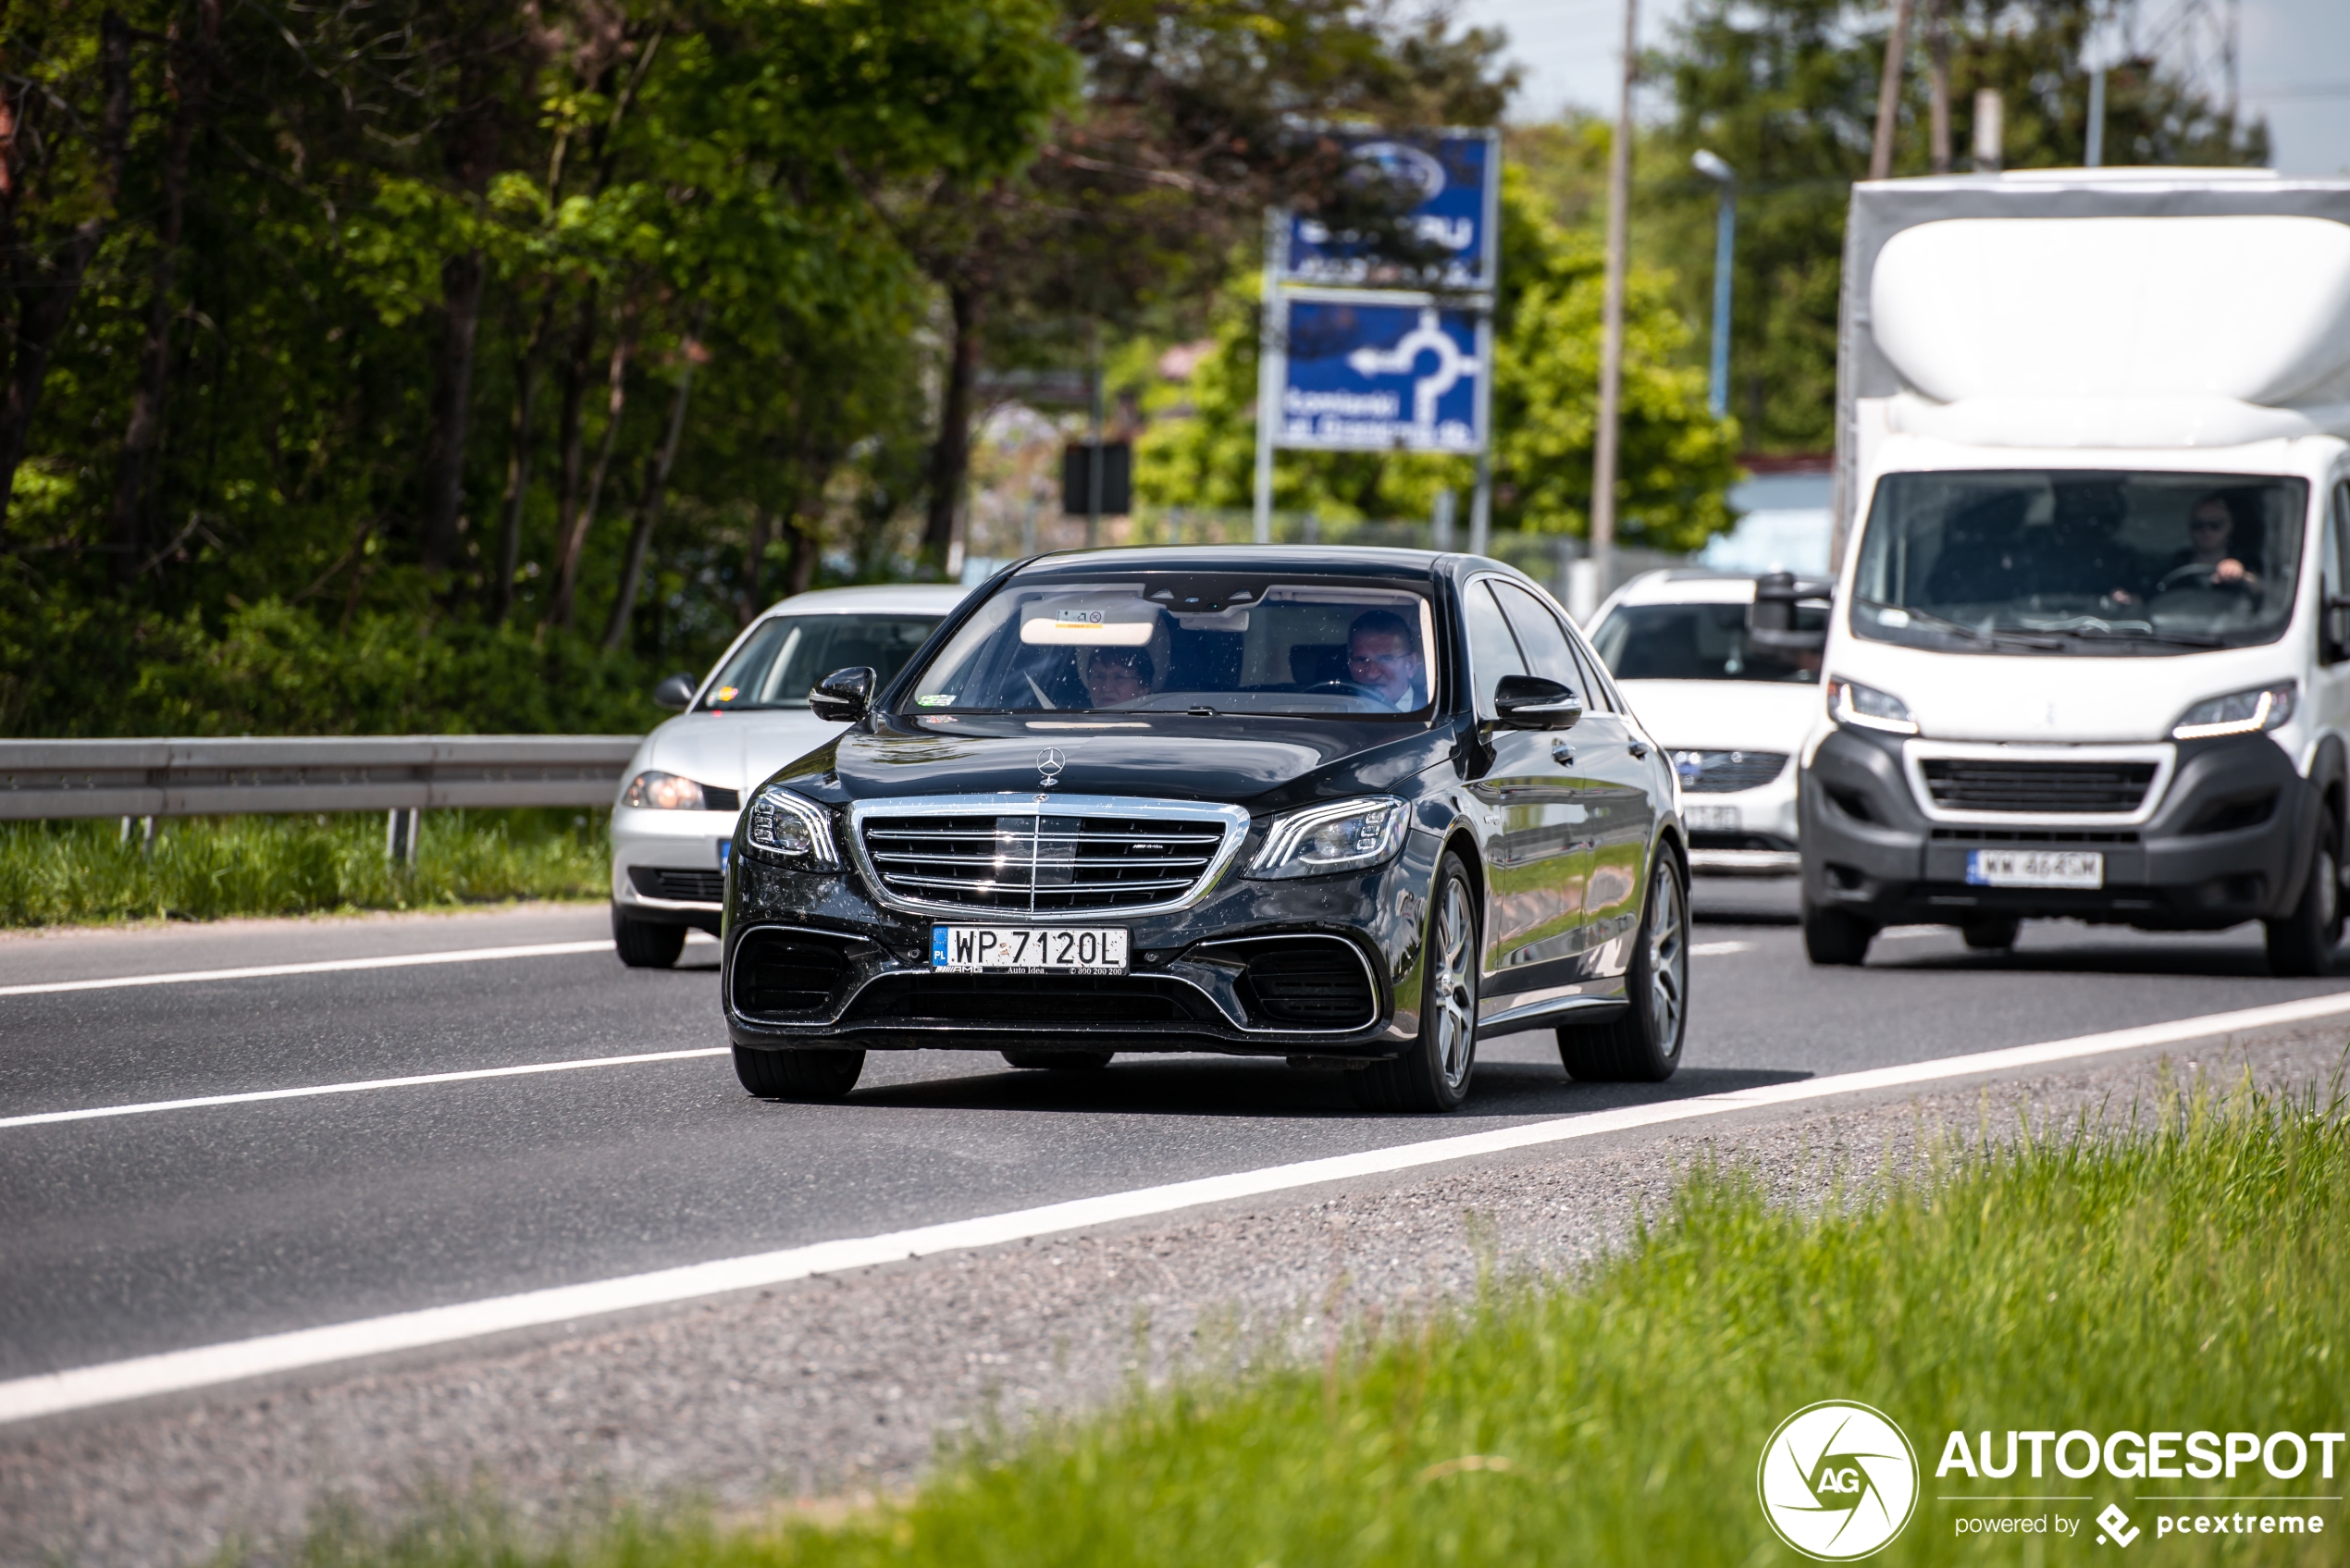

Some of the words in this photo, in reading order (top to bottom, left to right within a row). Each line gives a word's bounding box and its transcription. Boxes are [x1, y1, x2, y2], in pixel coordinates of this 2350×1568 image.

[934, 950, 946, 960] PL
[956, 931, 997, 964] WP
[1012, 931, 1119, 965] 7120L
